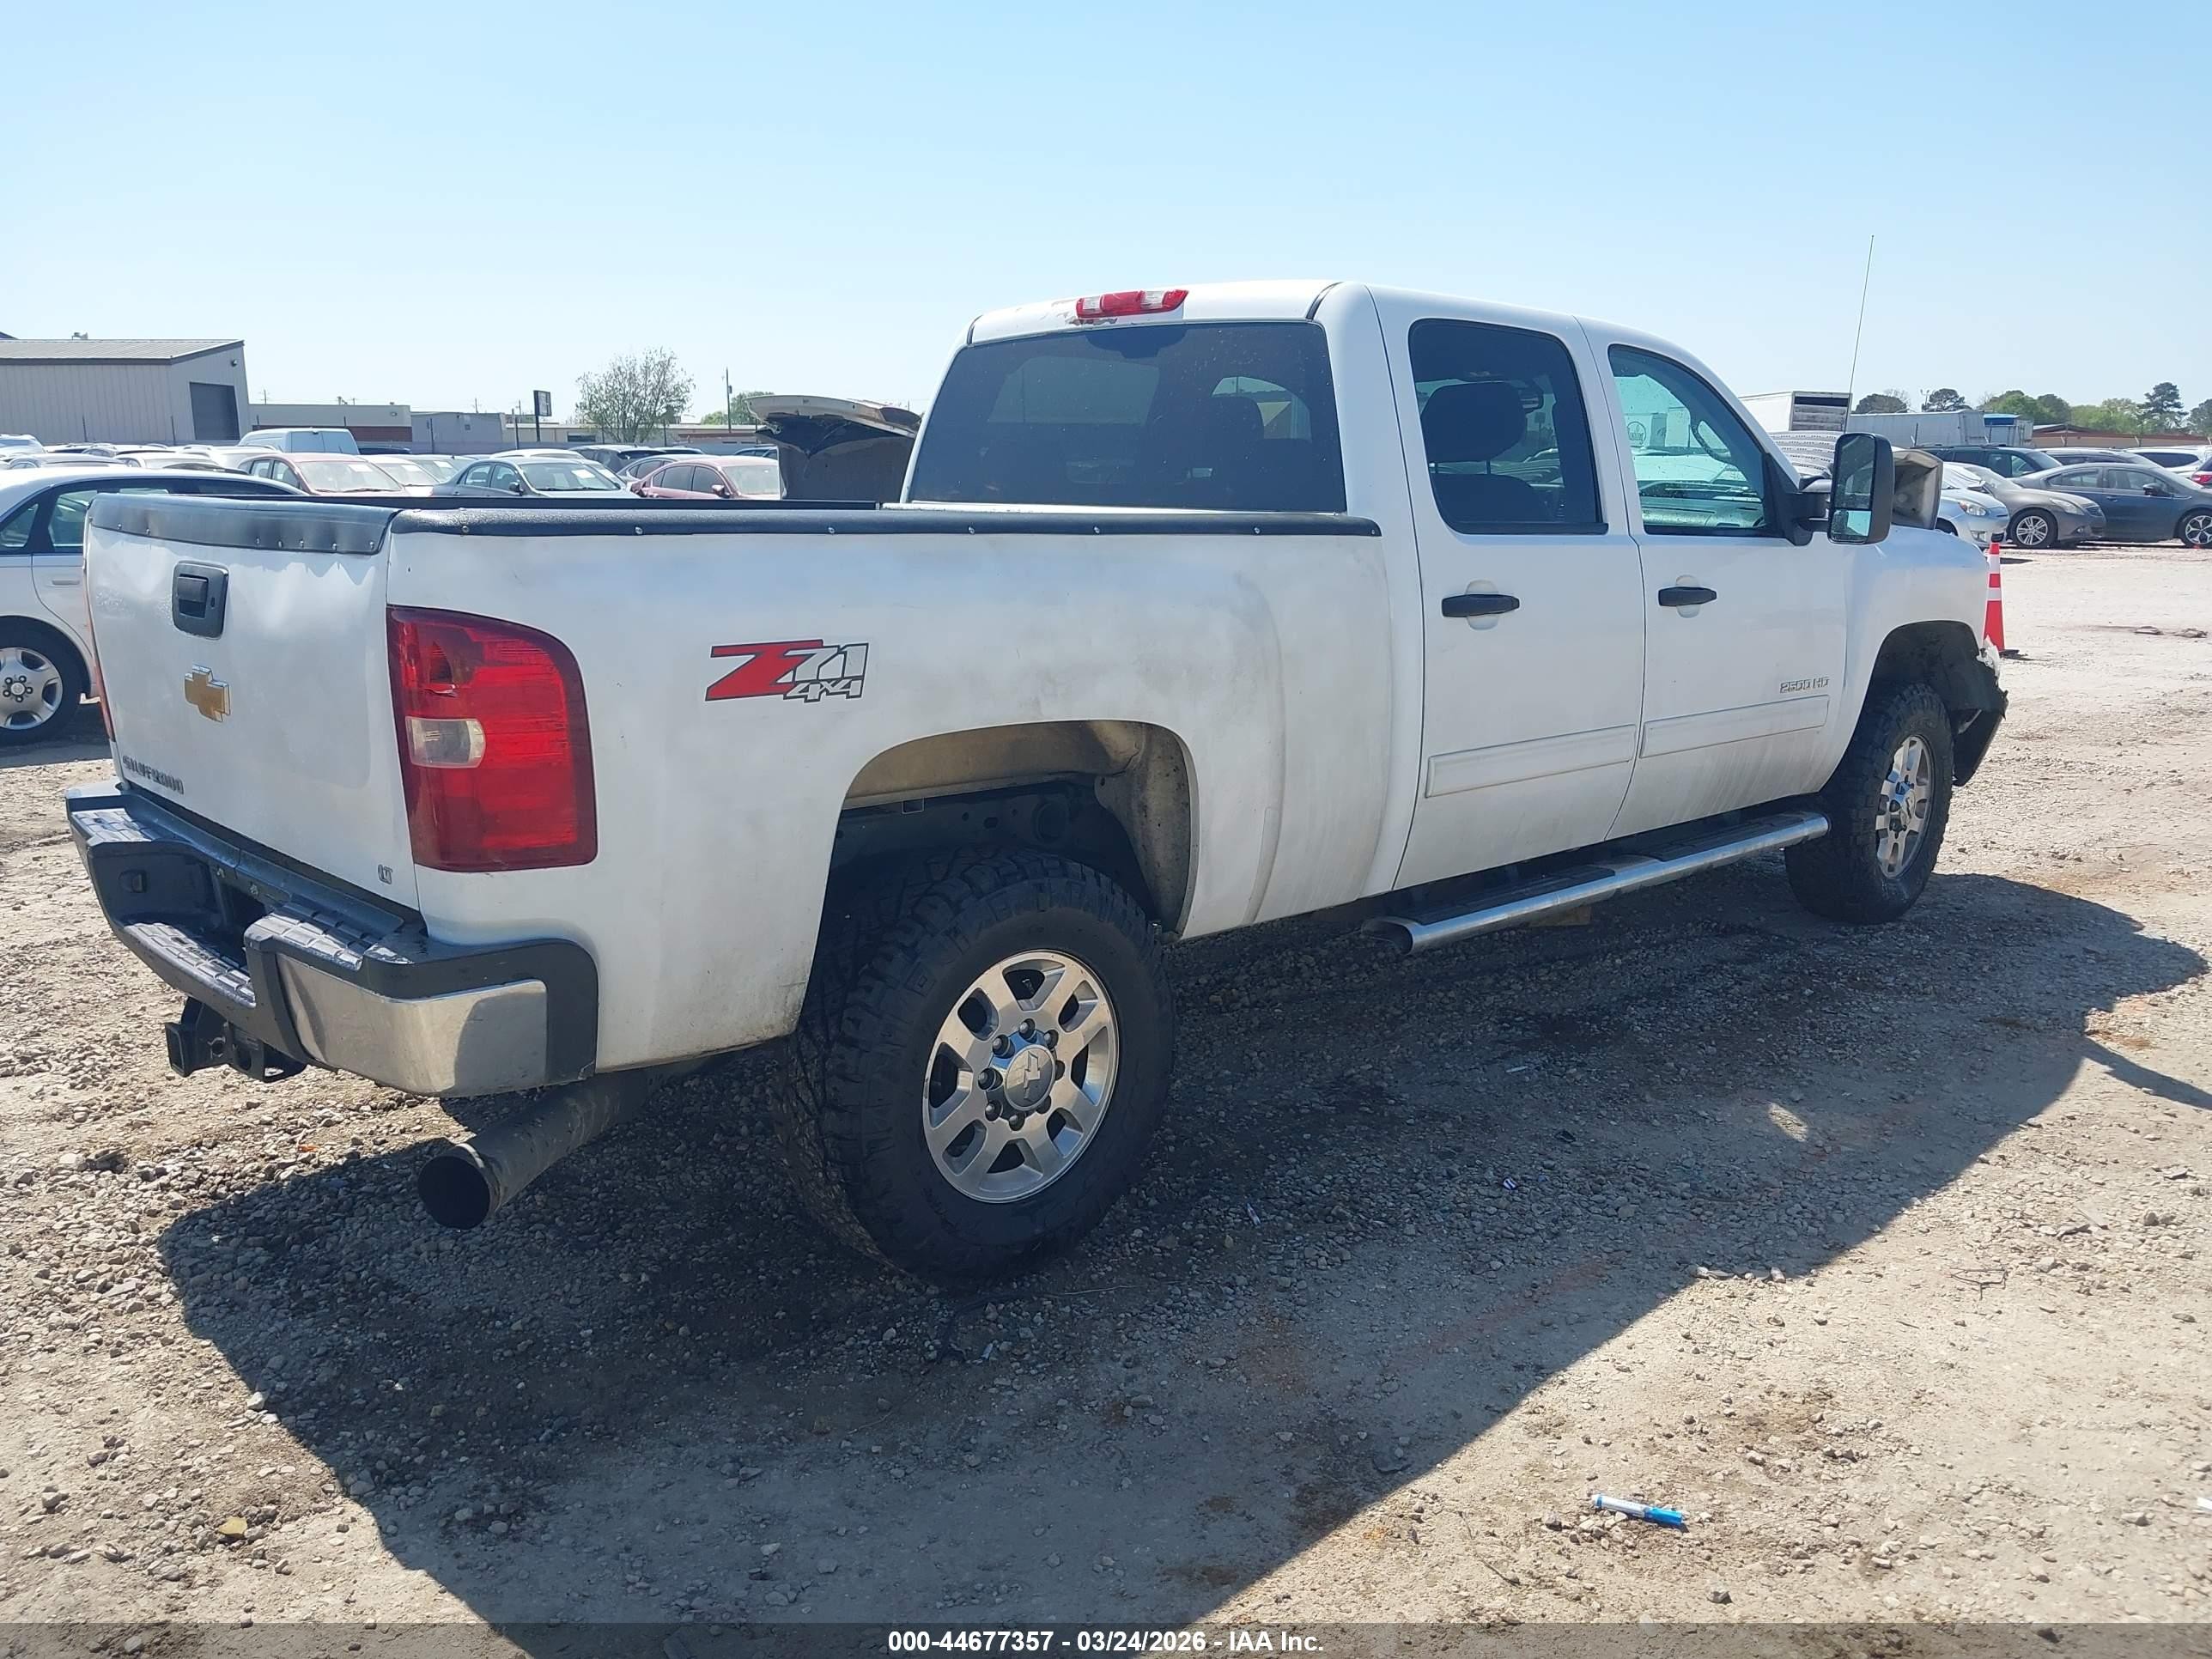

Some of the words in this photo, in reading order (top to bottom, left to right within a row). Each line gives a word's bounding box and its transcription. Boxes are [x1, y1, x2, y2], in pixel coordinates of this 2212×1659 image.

[705, 639, 869, 701] Z71
[1812, 676, 1830, 689] HD
[378, 864, 393, 884] LT
